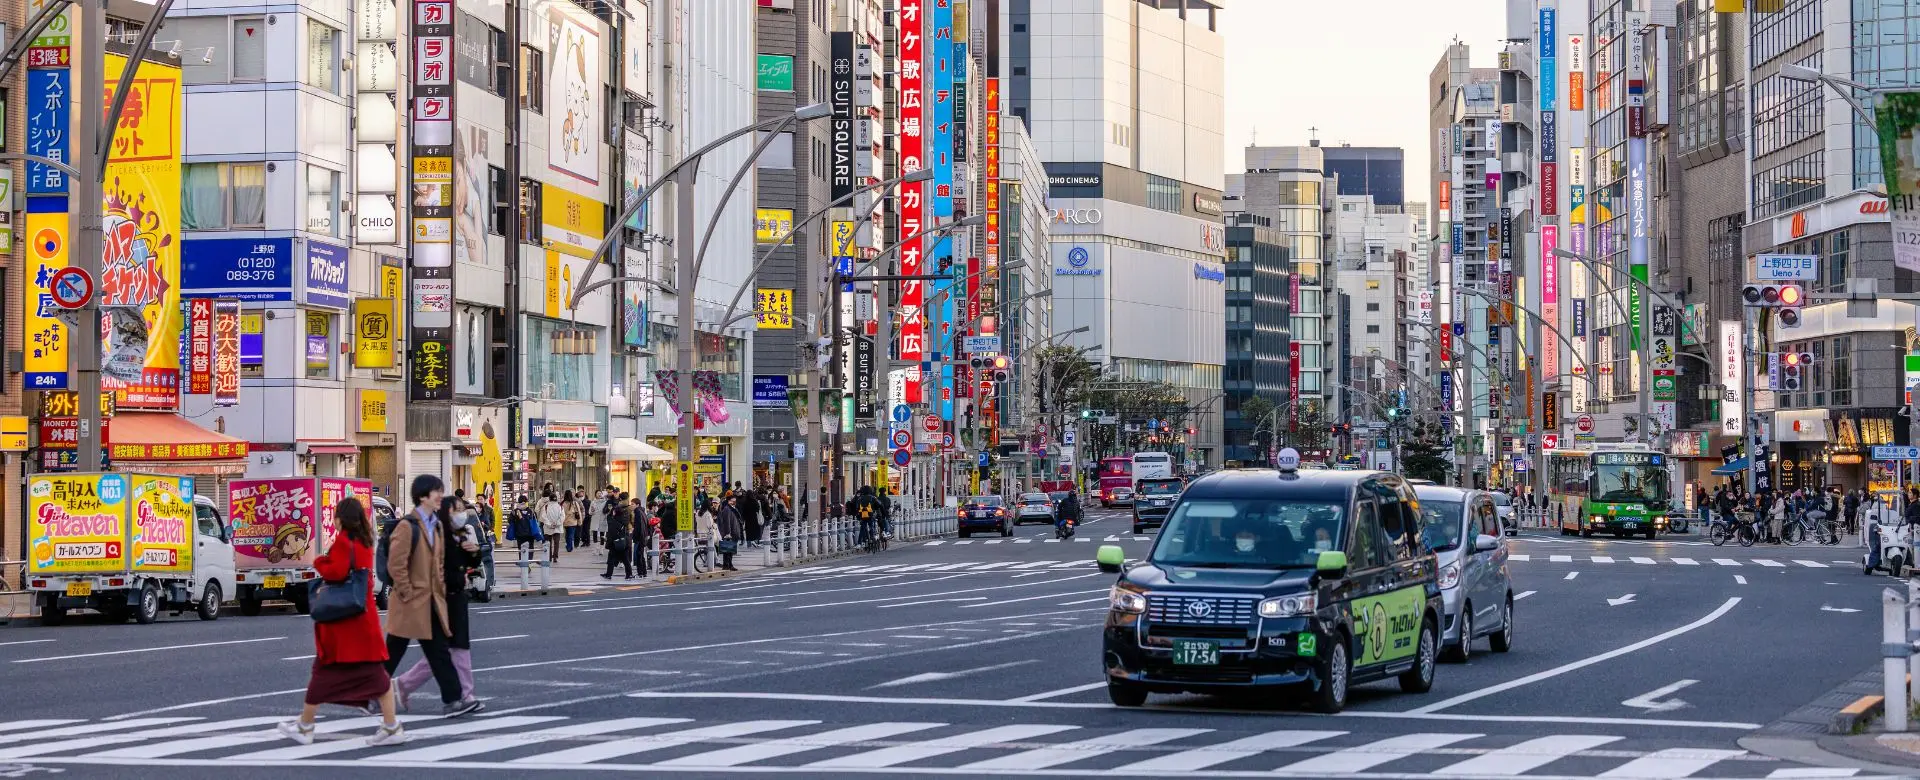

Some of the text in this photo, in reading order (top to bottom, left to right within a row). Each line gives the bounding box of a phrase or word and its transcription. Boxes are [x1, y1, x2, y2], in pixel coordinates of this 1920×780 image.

[36, 50, 59, 65] 3階
[758, 61, 790, 77] エイブル
[902, 2, 921, 137] オケ歌広場
[31, 113, 42, 152] イシイ
[45, 72, 63, 188] スポーツ用品
[835, 81, 849, 186] SUIT SQUARE
[1047, 176, 1099, 184] OHO CINEMAS
[1633, 180, 1644, 238] 東急リバブル
[1859, 200, 1889, 214] au
[360, 217, 394, 227] CHILO
[1049, 207, 1102, 225] PARCO
[238, 257, 275, 269] (0120)
[1762, 257, 1812, 269] 上野四丁目
[227, 270, 275, 281] 089-376
[956, 267, 964, 294] NOVA
[1772, 269, 1793, 277] Ueno
[365, 317, 384, 336] 質
[51, 324, 60, 352] 牛めし
[193, 301, 209, 372] 外貨両替
[966, 337, 999, 347] 上野四丁目
[34, 334, 43, 358] 定食
[217, 314, 237, 392] み大歓迎
[361, 341, 388, 351] 大黒屋
[422, 341, 444, 389] 四季香
[860, 353, 868, 374] SUIT
[36, 375, 57, 385] 24h
[43, 420, 69, 428] MONEY
[1279, 456, 1295, 464] km
[53, 480, 96, 500] 高収入
[59, 546, 102, 556] ガールズヘブン
[1268, 636, 1286, 646] km
[1184, 650, 1217, 664] 17-54
